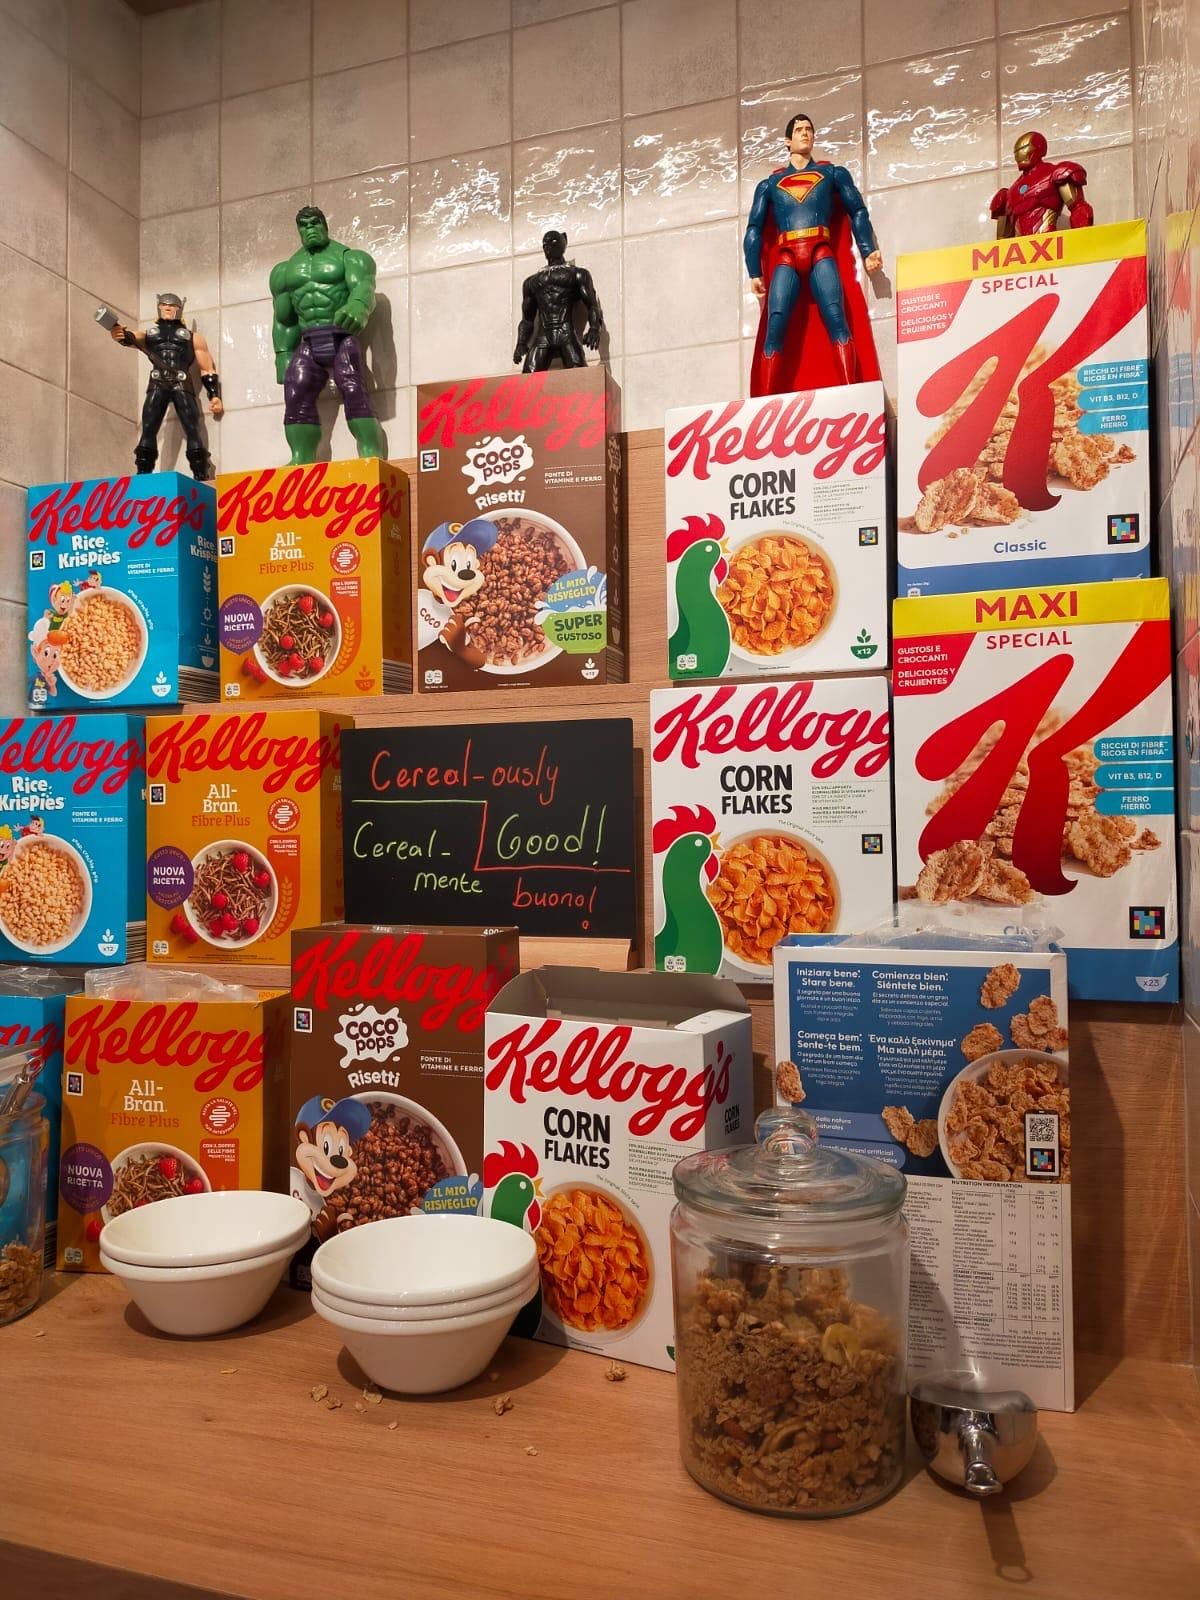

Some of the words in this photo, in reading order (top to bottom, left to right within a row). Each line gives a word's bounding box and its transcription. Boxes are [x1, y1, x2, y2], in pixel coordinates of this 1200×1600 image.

[972, 236, 1063, 271] MAXI
[981, 272, 1059, 294] SPECIAL
[900, 296, 936, 306] GUSTOSI
[901, 301, 947, 314] CROCCANTI
[901, 314, 947, 327] DELICIOSOS
[901, 323, 946, 335] CRUJIENTES
[1083, 367, 1107, 376] RICCHI
[1109, 366, 1117, 374] DI
[1083, 373, 1106, 383] RICOS
[1108, 372, 1118, 380] EN
[1089, 395, 1101, 404] VIT
[1131, 392, 1138, 400] D
[1100, 420, 1128, 430] HIERRO
[1102, 414, 1126, 422] FERRO
[482, 460, 520, 481] pops
[544, 471, 566, 479] FONTE
[566, 470, 573, 478] DI
[544, 477, 575, 485] VITAMINE
[581, 475, 602, 483] FERRO
[729, 468, 796, 500] CORN
[217, 462, 404, 539] Kellogg's
[475, 489, 526, 510] Risetti
[28, 476, 207, 550] Kellogg's
[729, 496, 796, 521] FLAKES
[71, 534, 106, 551] Rice
[274, 532, 303, 548] All-
[993, 539, 1047, 554] Classic
[58, 551, 121, 570] Krispies
[259, 562, 288, 575] Fibre
[291, 560, 315, 573] Plus
[555, 582, 565, 591] IL
[566, 577, 586, 588] MIO
[547, 585, 596, 603] RISVEGLIO
[975, 591, 1077, 624] MAXI
[224, 612, 255, 624] NUOVA
[554, 613, 603, 632] SUPER
[223, 623, 255, 632] RICETTA
[556, 631, 602, 642] GUSTOSO
[986, 630, 1073, 650] SPECIAL
[857, 647, 872, 655] x12
[897, 646, 934, 656] GUSTOSI
[935, 645, 941, 653] E
[897, 653, 948, 665] CROCCANTI
[897, 668, 949, 679] DELICIOSOS
[949, 667, 956, 675] Y
[897, 676, 948, 688] CRUJIENTES
[1101, 742, 1129, 750] RICCHI
[1101, 749, 1127, 757] RICOS
[1128, 749, 1139, 757] EN
[371, 738, 560, 806] Cereal-ously
[719, 764, 793, 793] CORN
[1108, 773, 1123, 781] VIT
[1155, 772, 1162, 780] D
[11, 776, 48, 794] Rice
[207, 784, 237, 799] All-
[721, 794, 793, 815] FLAKES
[1120, 803, 1151, 811] HIERRO
[1122, 796, 1149, 804] FERRO
[191, 814, 222, 827] Fibre
[224, 813, 251, 827] Plus
[353, 821, 452, 859] Cereal-
[497, 804, 607, 867] Good!
[153, 866, 185, 876] NUOVA
[152, 877, 186, 885] RICETTA
[512, 876, 598, 930] buono!
[796, 967, 832, 977] Iniziare
[871, 970, 921, 981] Comienza
[801, 977, 827, 987] Stare
[829, 978, 855, 988] bene.
[876, 980, 917, 990] Siéntete
[919, 981, 944, 992] bien.
[797, 1030, 836, 1042] Começa
[355, 1034, 395, 1056] pops
[797, 1040, 838, 1050] Sente-te
[839, 1042, 863, 1052] bem.
[877, 1044, 895, 1054] Μια
[896, 1046, 920, 1056] καλή
[921, 1048, 947, 1058] μέρα.
[420, 1055, 443, 1063] FONTE
[420, 1063, 453, 1072] VITAMINE
[460, 1065, 484, 1073] FERRO
[347, 1068, 401, 1088] Risetti
[485, 1018, 732, 1142] Kellogg's
[128, 1079, 164, 1097] All-
[111, 1112, 146, 1127] Fibre
[149, 1113, 180, 1129] Plus
[724, 1103, 740, 1125] CORN
[543, 1105, 611, 1145] CORN
[544, 1138, 611, 1170] FLAKES
[67, 1164, 103, 1178] NUOVA
[67, 1176, 104, 1189] RICETTA
[983, 1181, 1023, 1189] INFORMATION
[432, 1187, 443, 1198] IL
[445, 1185, 467, 1196] MIO
[424, 1196, 478, 1212] RISVEGLIO
